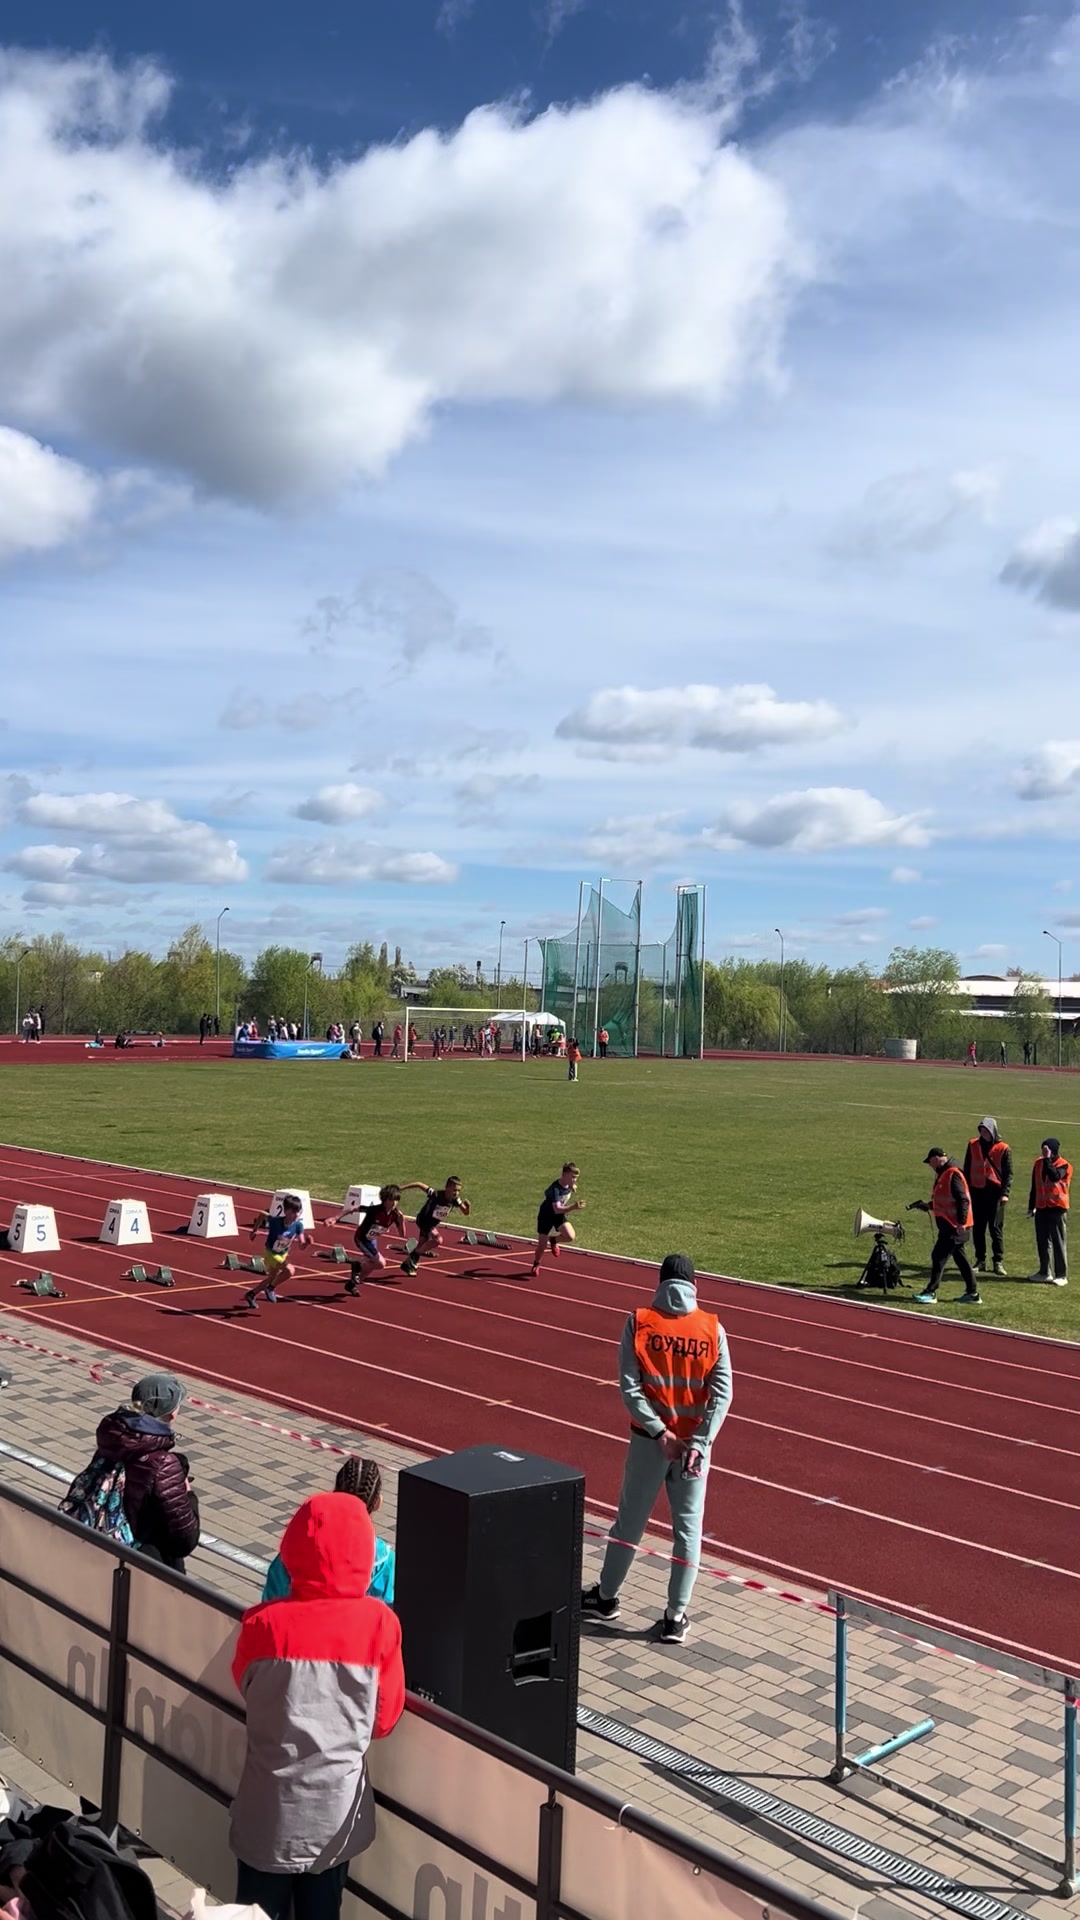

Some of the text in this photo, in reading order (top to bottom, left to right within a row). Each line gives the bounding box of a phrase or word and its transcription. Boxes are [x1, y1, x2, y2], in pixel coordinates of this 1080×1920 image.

[108, 1217, 116, 1235] 4
[130, 1217, 139, 1235] 4
[197, 1210, 204, 1227] 3
[218, 1211, 226, 1228] 3
[13, 1223, 21, 1241] 5
[36, 1224, 46, 1242] 5
[651, 1334, 709, 1359] СУДДЯ
